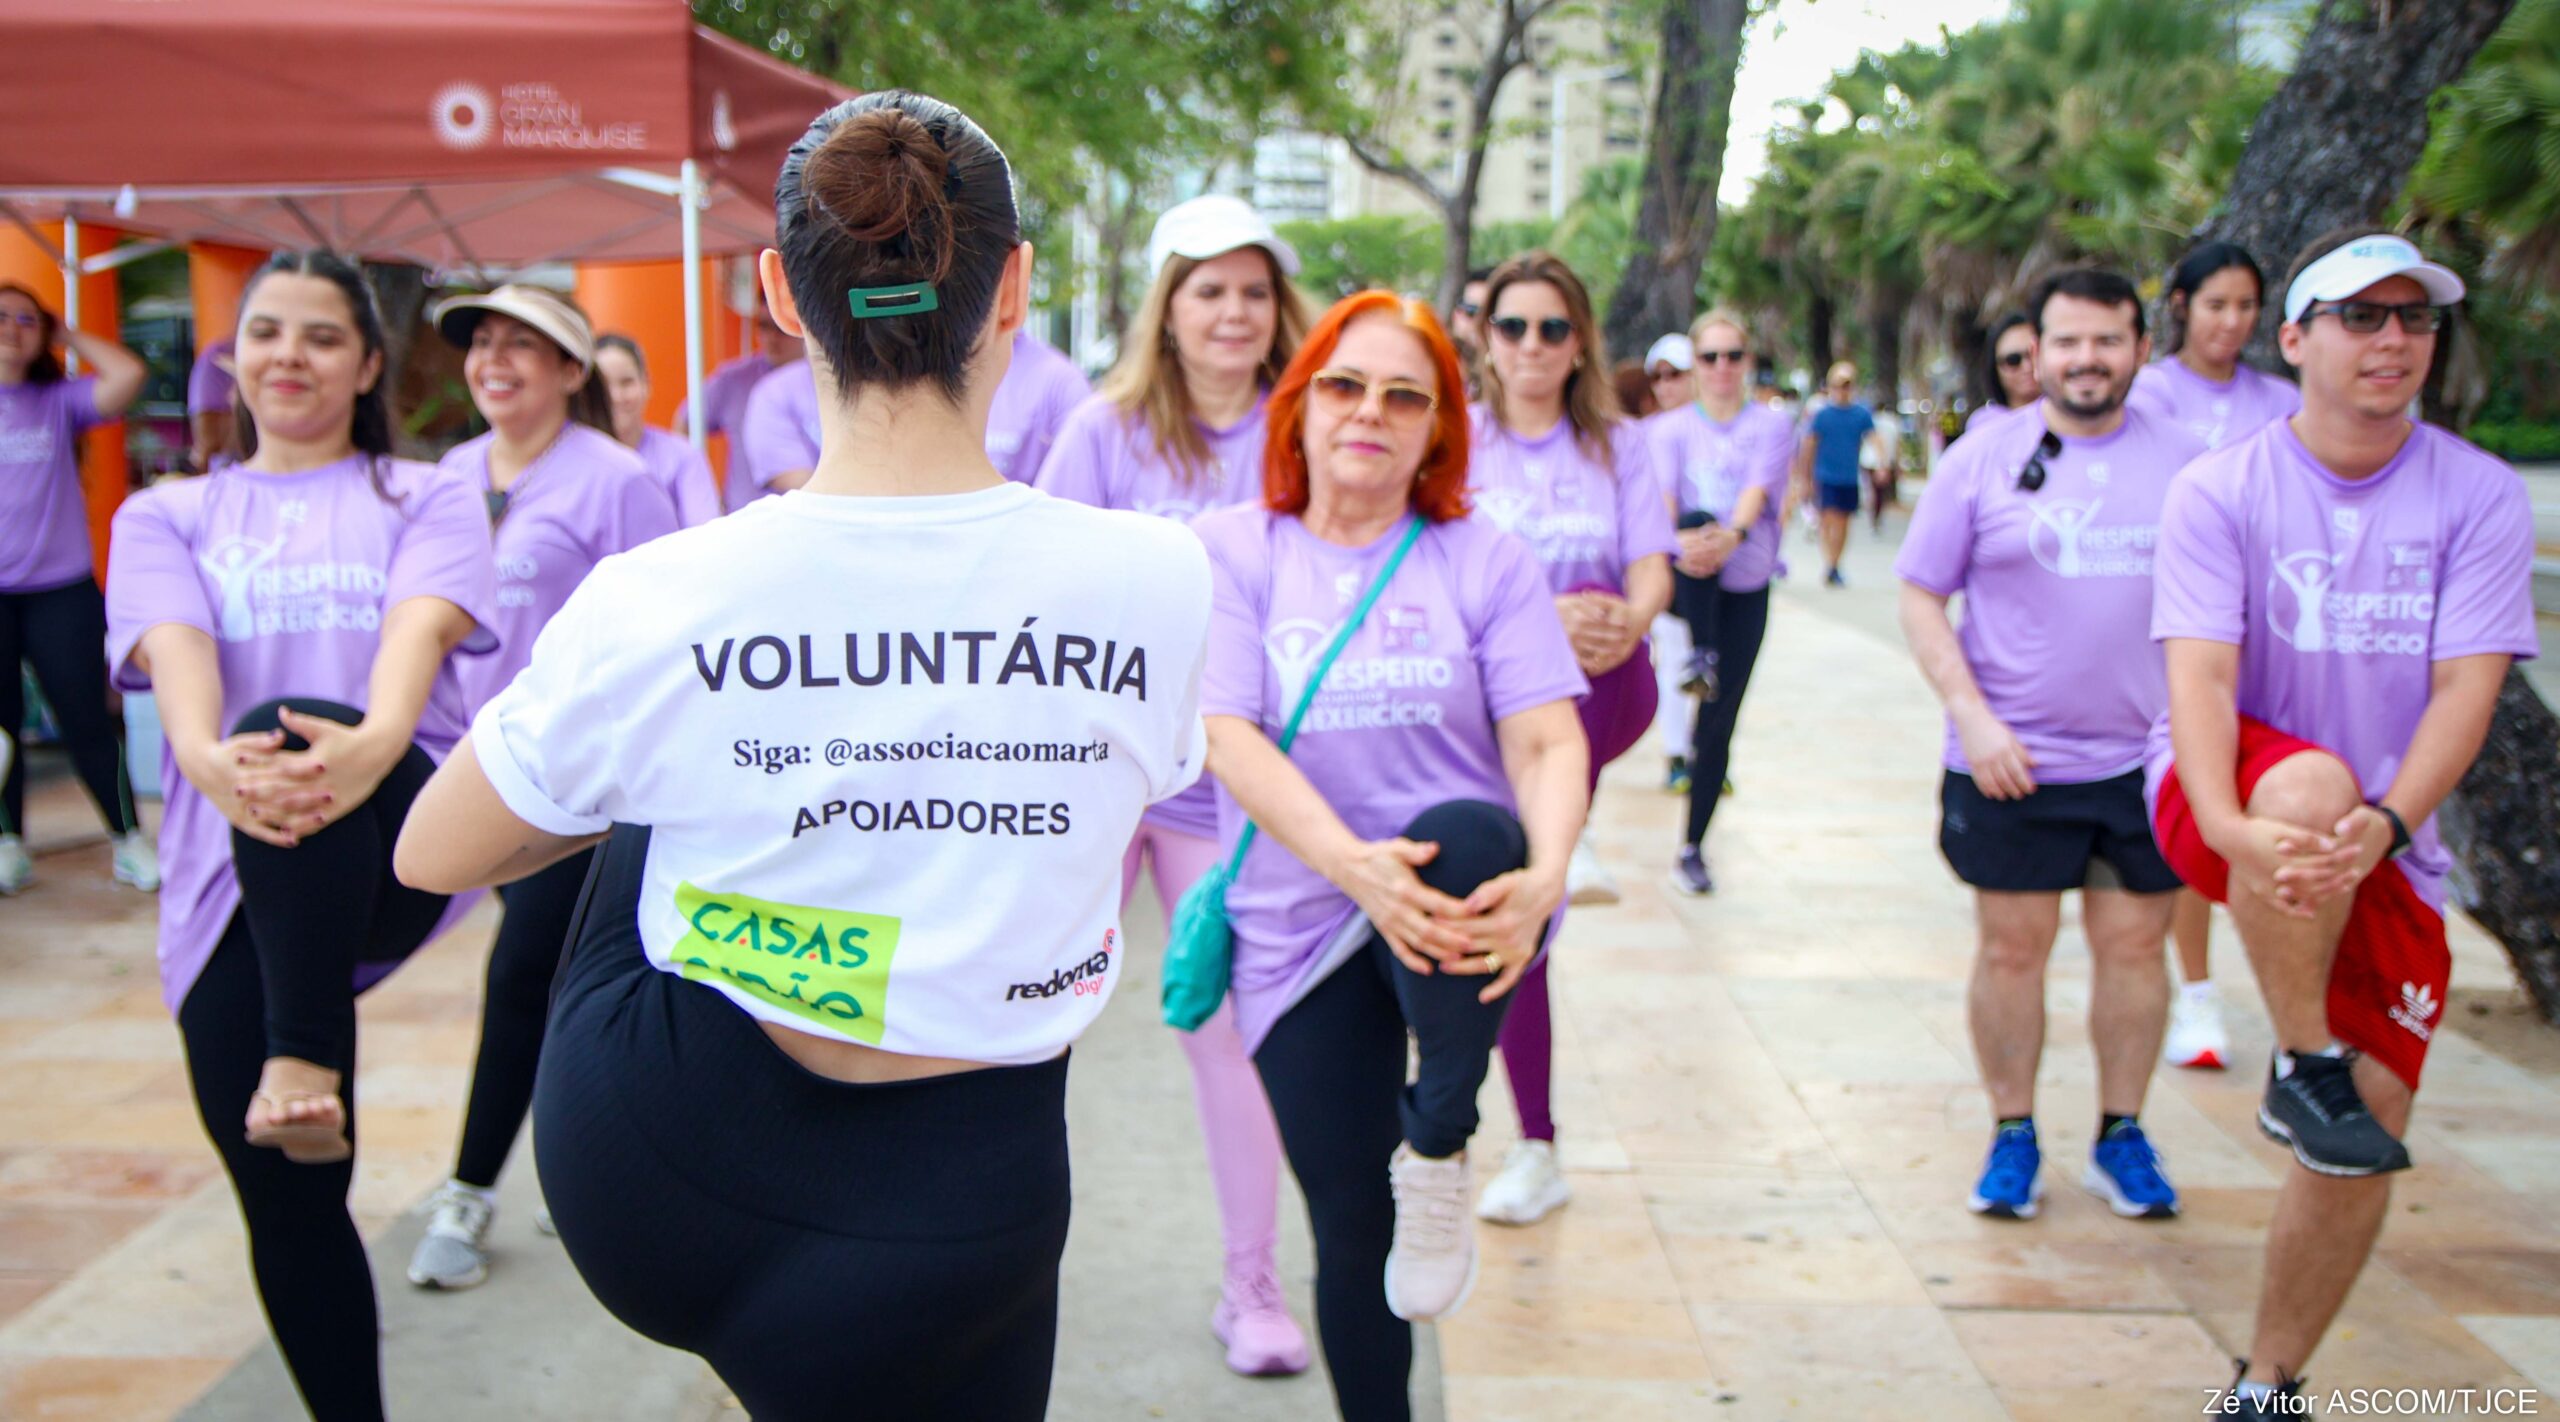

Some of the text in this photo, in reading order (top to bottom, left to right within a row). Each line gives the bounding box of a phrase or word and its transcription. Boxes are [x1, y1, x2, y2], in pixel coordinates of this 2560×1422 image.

[502, 122, 648, 149] MARQUISE
[691, 617, 1147, 702] VOLUNTÁRIA
[733, 733, 1109, 774] Siga: @associacaomarta
[792, 799, 1071, 838] APOIADORES
[692, 902, 870, 968] CASAS
[1005, 951, 1109, 1001] redoma
